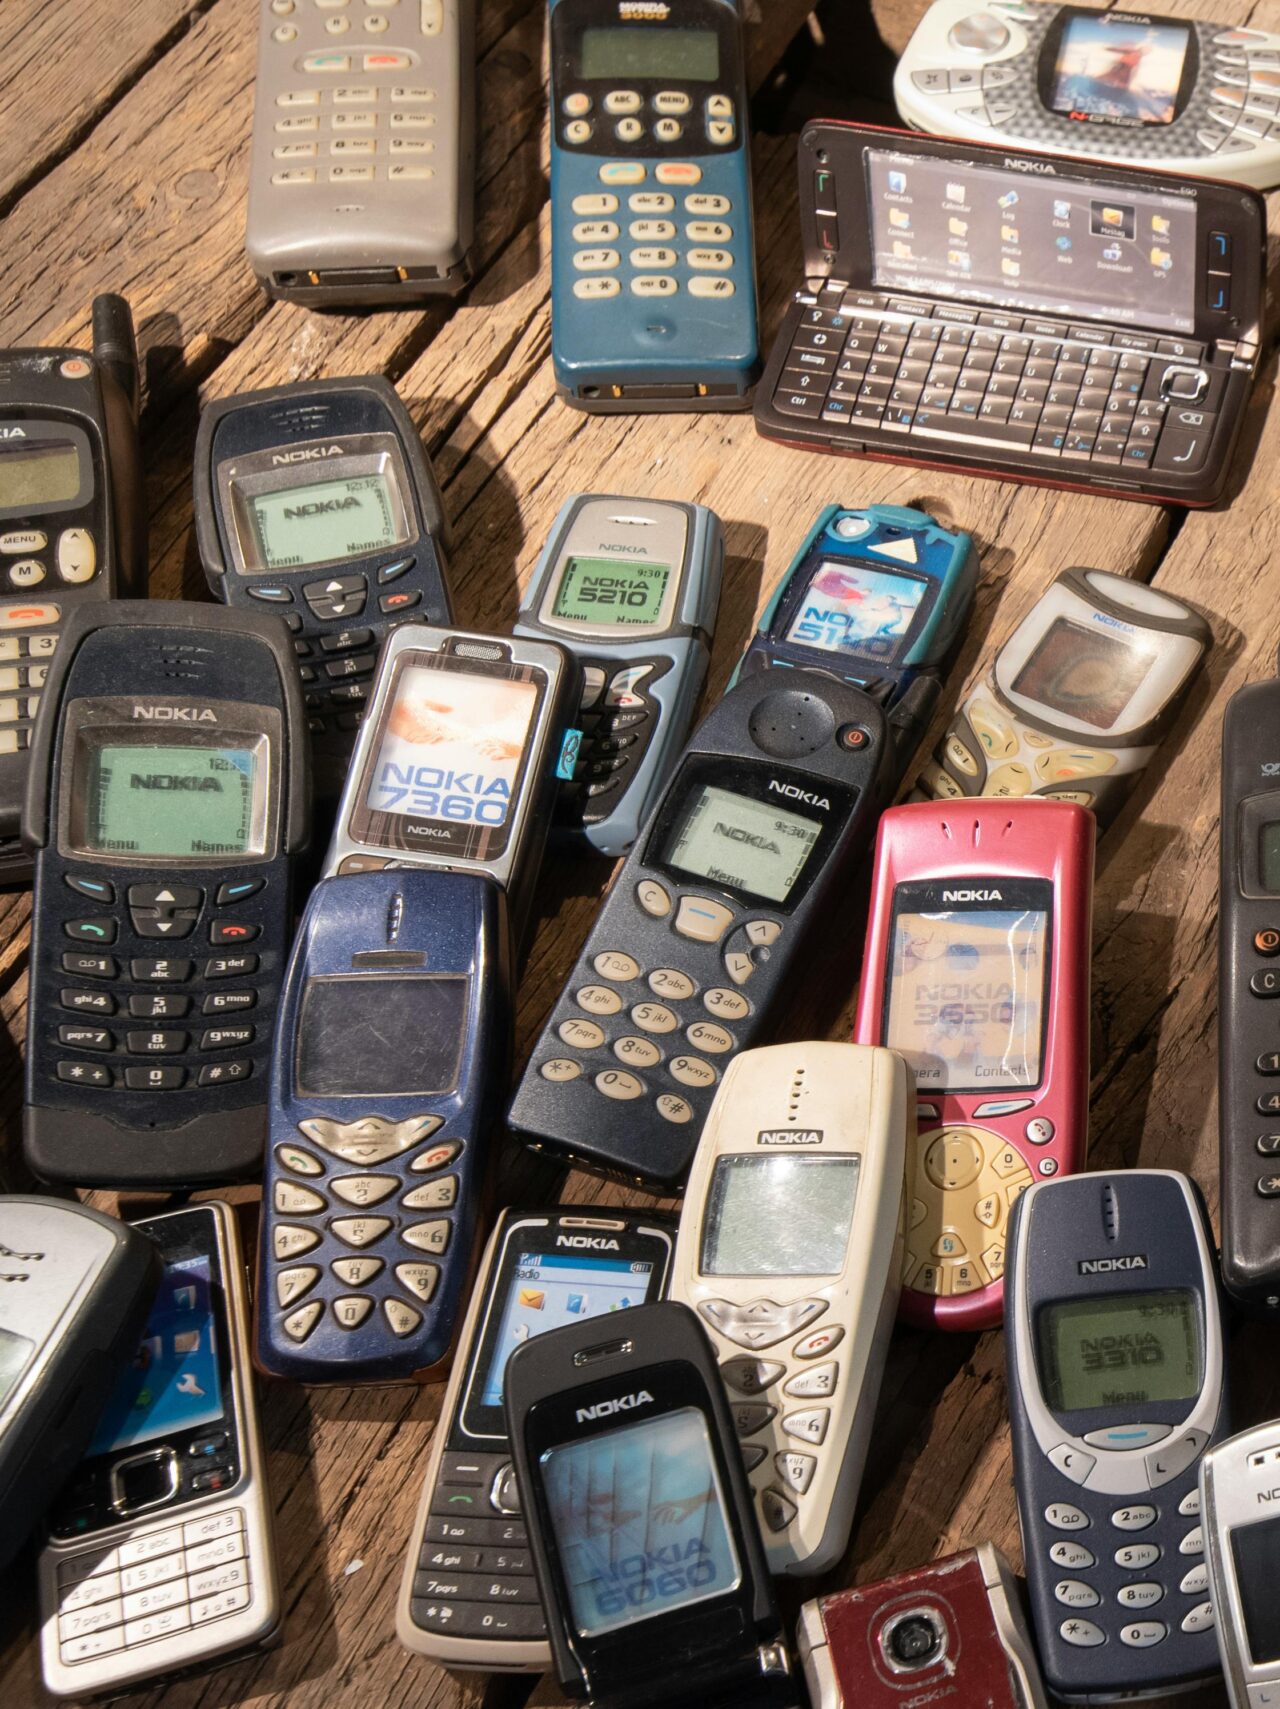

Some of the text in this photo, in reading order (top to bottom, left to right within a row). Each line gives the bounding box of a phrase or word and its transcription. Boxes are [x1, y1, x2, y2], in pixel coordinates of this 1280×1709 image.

[1107, 14, 1152, 25] NOKIA
[614, 95, 631, 104] ABC
[660, 96, 685, 104] MENU
[1004, 158, 1057, 174] NOKIA
[1180, 187, 1198, 197] E90
[938, 309, 975, 322] Messaging
[791, 397, 807, 406] Ctrl
[272, 445, 344, 466] NOKIA
[283, 496, 362, 520] NOKIA
[4, 535, 37, 545] MENU
[347, 539, 391, 553] Names
[599, 543, 648, 555] NOKIA
[637, 568, 661, 579] 9:30
[582, 574, 650, 591] NOKIA
[577, 588, 649, 607] 5210
[557, 610, 589, 621] Menu
[133, 705, 218, 722] NOKIA
[130, 773, 224, 792] NOKIA
[380, 762, 511, 800] NOKIA
[769, 779, 831, 811] NOKIA
[377, 785, 509, 826] 7360
[407, 824, 452, 839] NOKIA
[712, 821, 781, 855] NOKIA
[191, 839, 244, 853] Names
[707, 865, 748, 888] Menu
[942, 889, 1003, 901] NOKIA
[227, 958, 246, 967] def
[1263, 974, 1275, 988] C
[226, 995, 250, 1003] mno
[915, 982, 1013, 1002] NOKIA
[74, 995, 93, 1005] ghi
[913, 1001, 1014, 1026] 3650
[67, 1031, 93, 1041] pqrs
[222, 1030, 251, 1040] wxyz
[975, 1065, 1030, 1077] Contacts
[1268, 1096, 1280, 1109] 4
[760, 1130, 823, 1145] NOKIA
[555, 1234, 621, 1251] NOKIA
[1081, 1256, 1146, 1274] NOKIA
[514, 1267, 540, 1280] Radio
[1080, 1331, 1161, 1353] NOKIA
[1081, 1346, 1165, 1375] 3310
[576, 1390, 655, 1423] NOKIA
[598, 1537, 711, 1581] NOKIA
[595, 1559, 717, 1616] 6060
[898, 1685, 959, 1709] NOKIA
